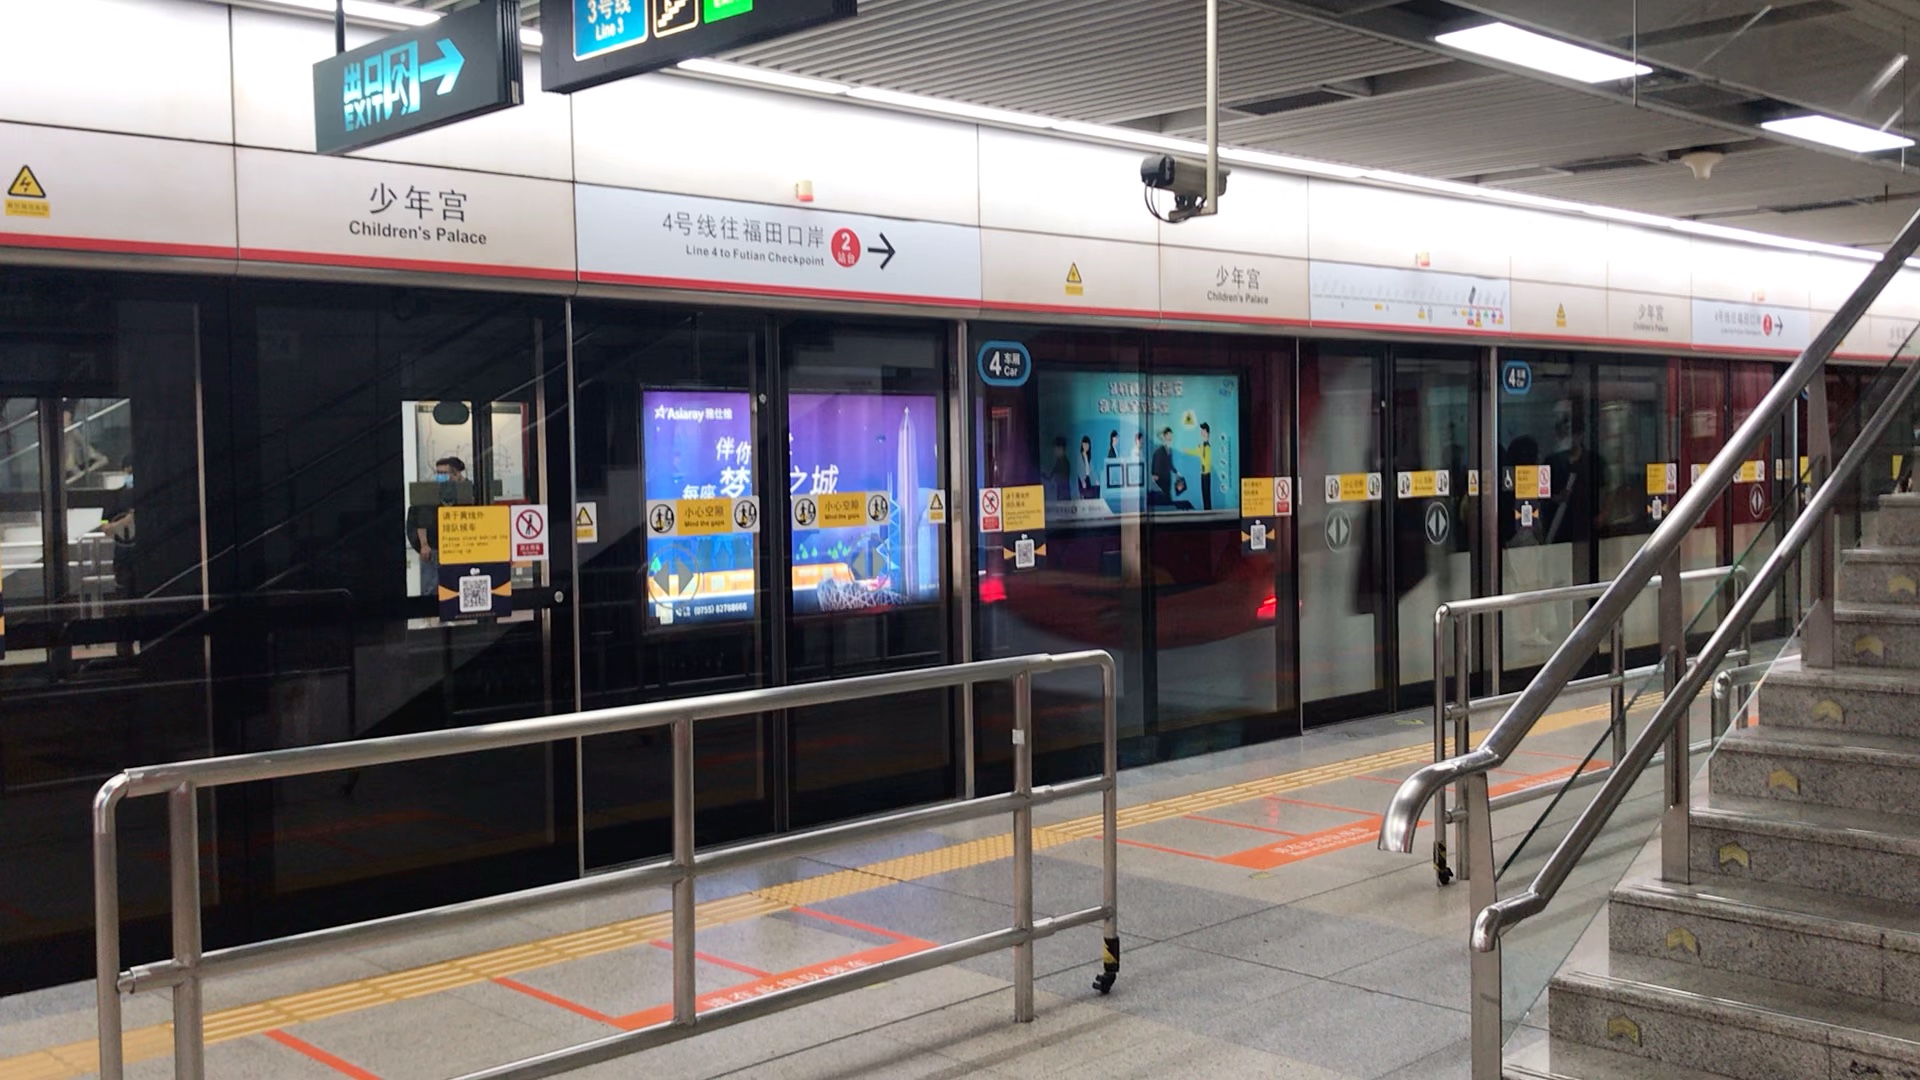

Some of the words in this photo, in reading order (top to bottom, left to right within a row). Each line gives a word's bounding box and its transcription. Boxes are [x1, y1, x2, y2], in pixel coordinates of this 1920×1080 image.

[587, 0, 632, 24] 3号线
[595, 21, 617, 41] Line
[617, 17, 625, 34] 3
[343, 53, 383, 104] 出口
[343, 93, 384, 132] EXIT
[369, 182, 468, 223] 少年宫
[349, 219, 432, 241] Children's
[436, 226, 488, 245] Palace
[662, 211, 826, 249] 4号线往福田口岸
[841, 232, 852, 251] 2
[685, 244, 710, 256] Line
[711, 246, 719, 257] 4
[720, 247, 731, 259] to
[733, 248, 766, 262] Futian
[768, 252, 825, 267] Checkpoint
[836, 250, 856, 265] 站台
[1216, 264, 1261, 290] 少年宫
[1206, 289, 1244, 303] Children's
[1245, 292, 1269, 304] Palace
[989, 350, 1002, 377] 4
[1003, 352, 1021, 366] 车厢
[1003, 365, 1018, 377] Car
[1508, 368, 1516, 388] 4
[667, 407, 704, 424] Asiaray
[442, 511, 485, 521] 请于黄线外
[684, 505, 724, 519] 小心空隙
[824, 499, 860, 512] 小心空隙
